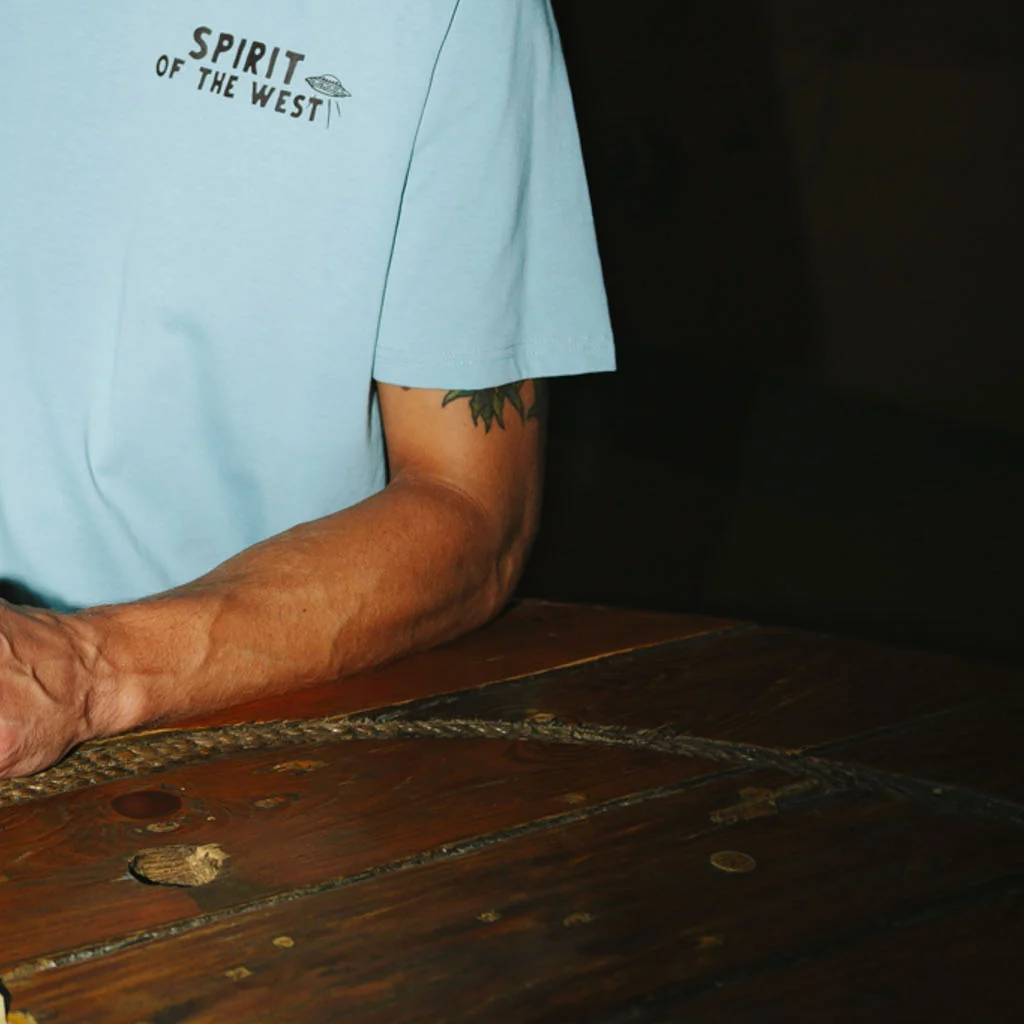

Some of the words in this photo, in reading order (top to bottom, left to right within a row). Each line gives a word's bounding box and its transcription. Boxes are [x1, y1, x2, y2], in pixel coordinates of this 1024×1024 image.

[188, 26, 306, 85] SPIRIT
[155, 54, 186, 79] OF
[197, 66, 239, 98] THE
[251, 81, 324, 122] WEST
